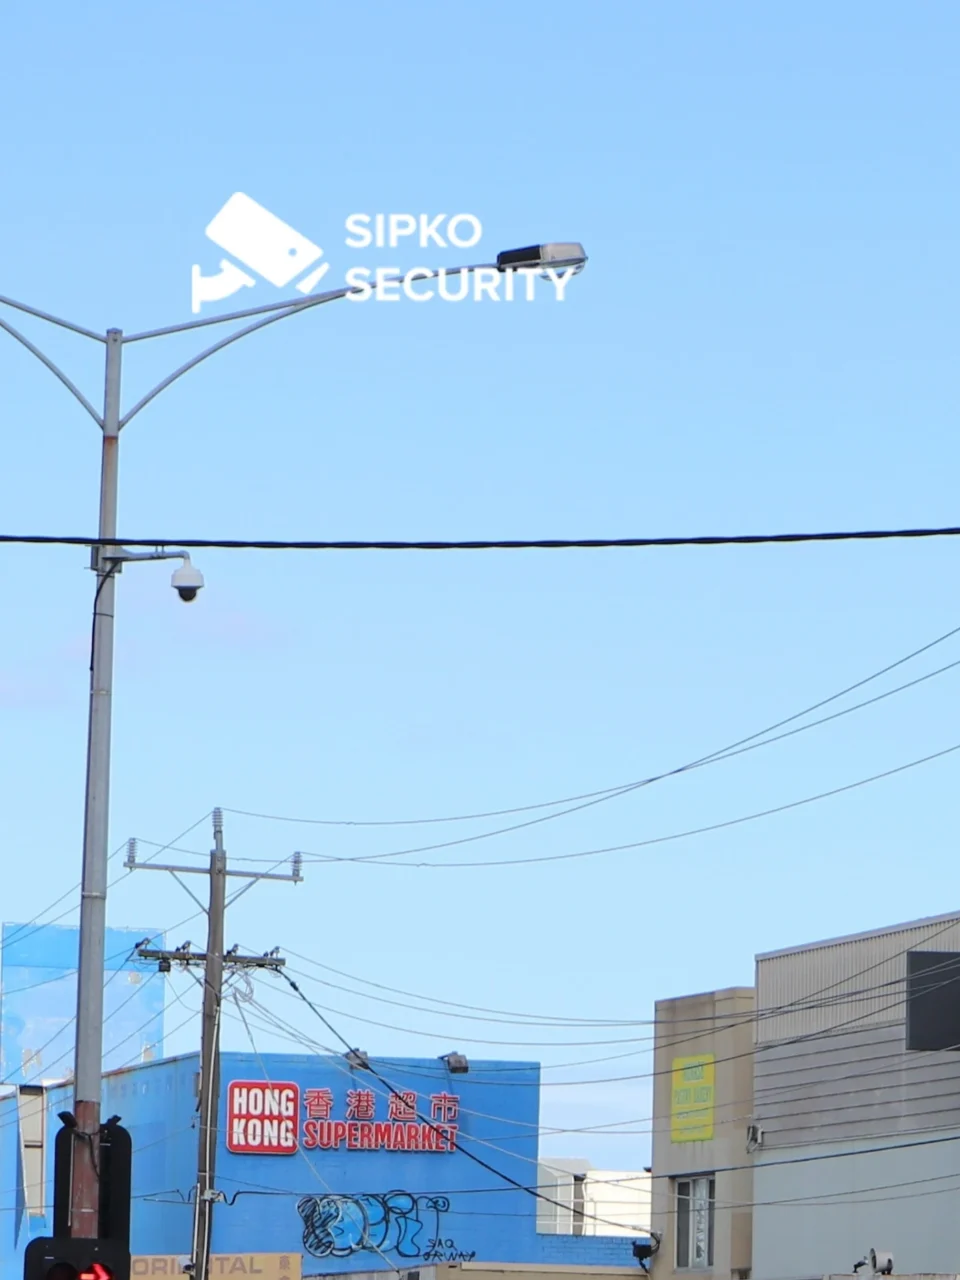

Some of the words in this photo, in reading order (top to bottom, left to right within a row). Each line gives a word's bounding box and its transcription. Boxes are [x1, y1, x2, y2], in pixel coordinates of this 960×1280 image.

[233, 1087, 295, 1117] HONG
[303, 1088, 460, 1122] 香港超市
[233, 1118, 295, 1147] KONG
[303, 1121, 458, 1151] SUPERMARKET
[132, 1256, 263, 1276] ORITAL
